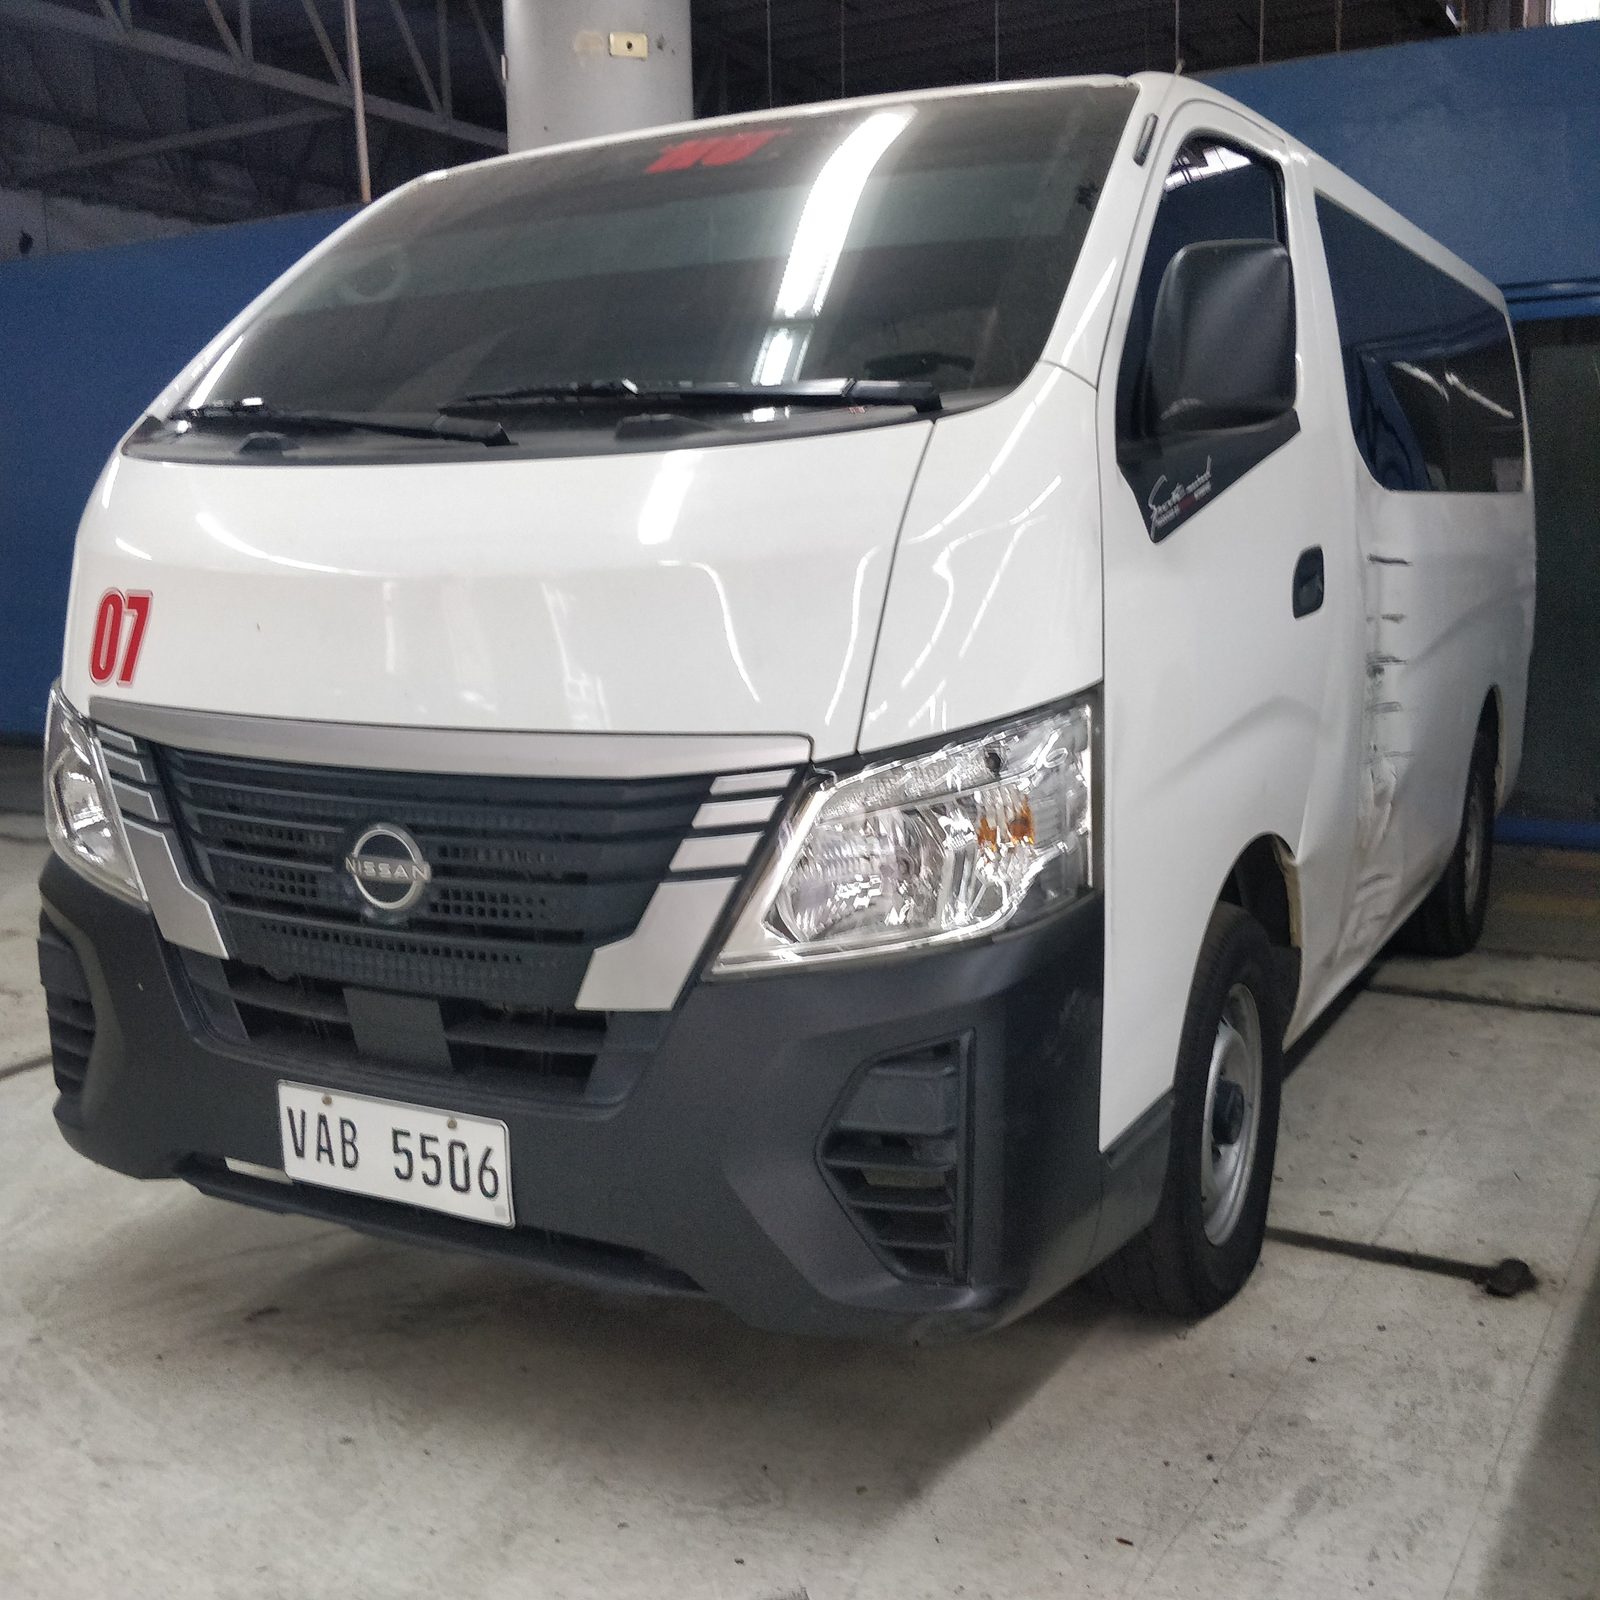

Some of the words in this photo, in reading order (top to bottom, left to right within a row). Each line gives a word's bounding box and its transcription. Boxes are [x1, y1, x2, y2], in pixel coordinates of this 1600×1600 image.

[89, 588, 153, 688] 07
[344, 855, 431, 883] NISSAN
[287, 1106, 359, 1169] VAB
[391, 1126, 499, 1199] 5506
